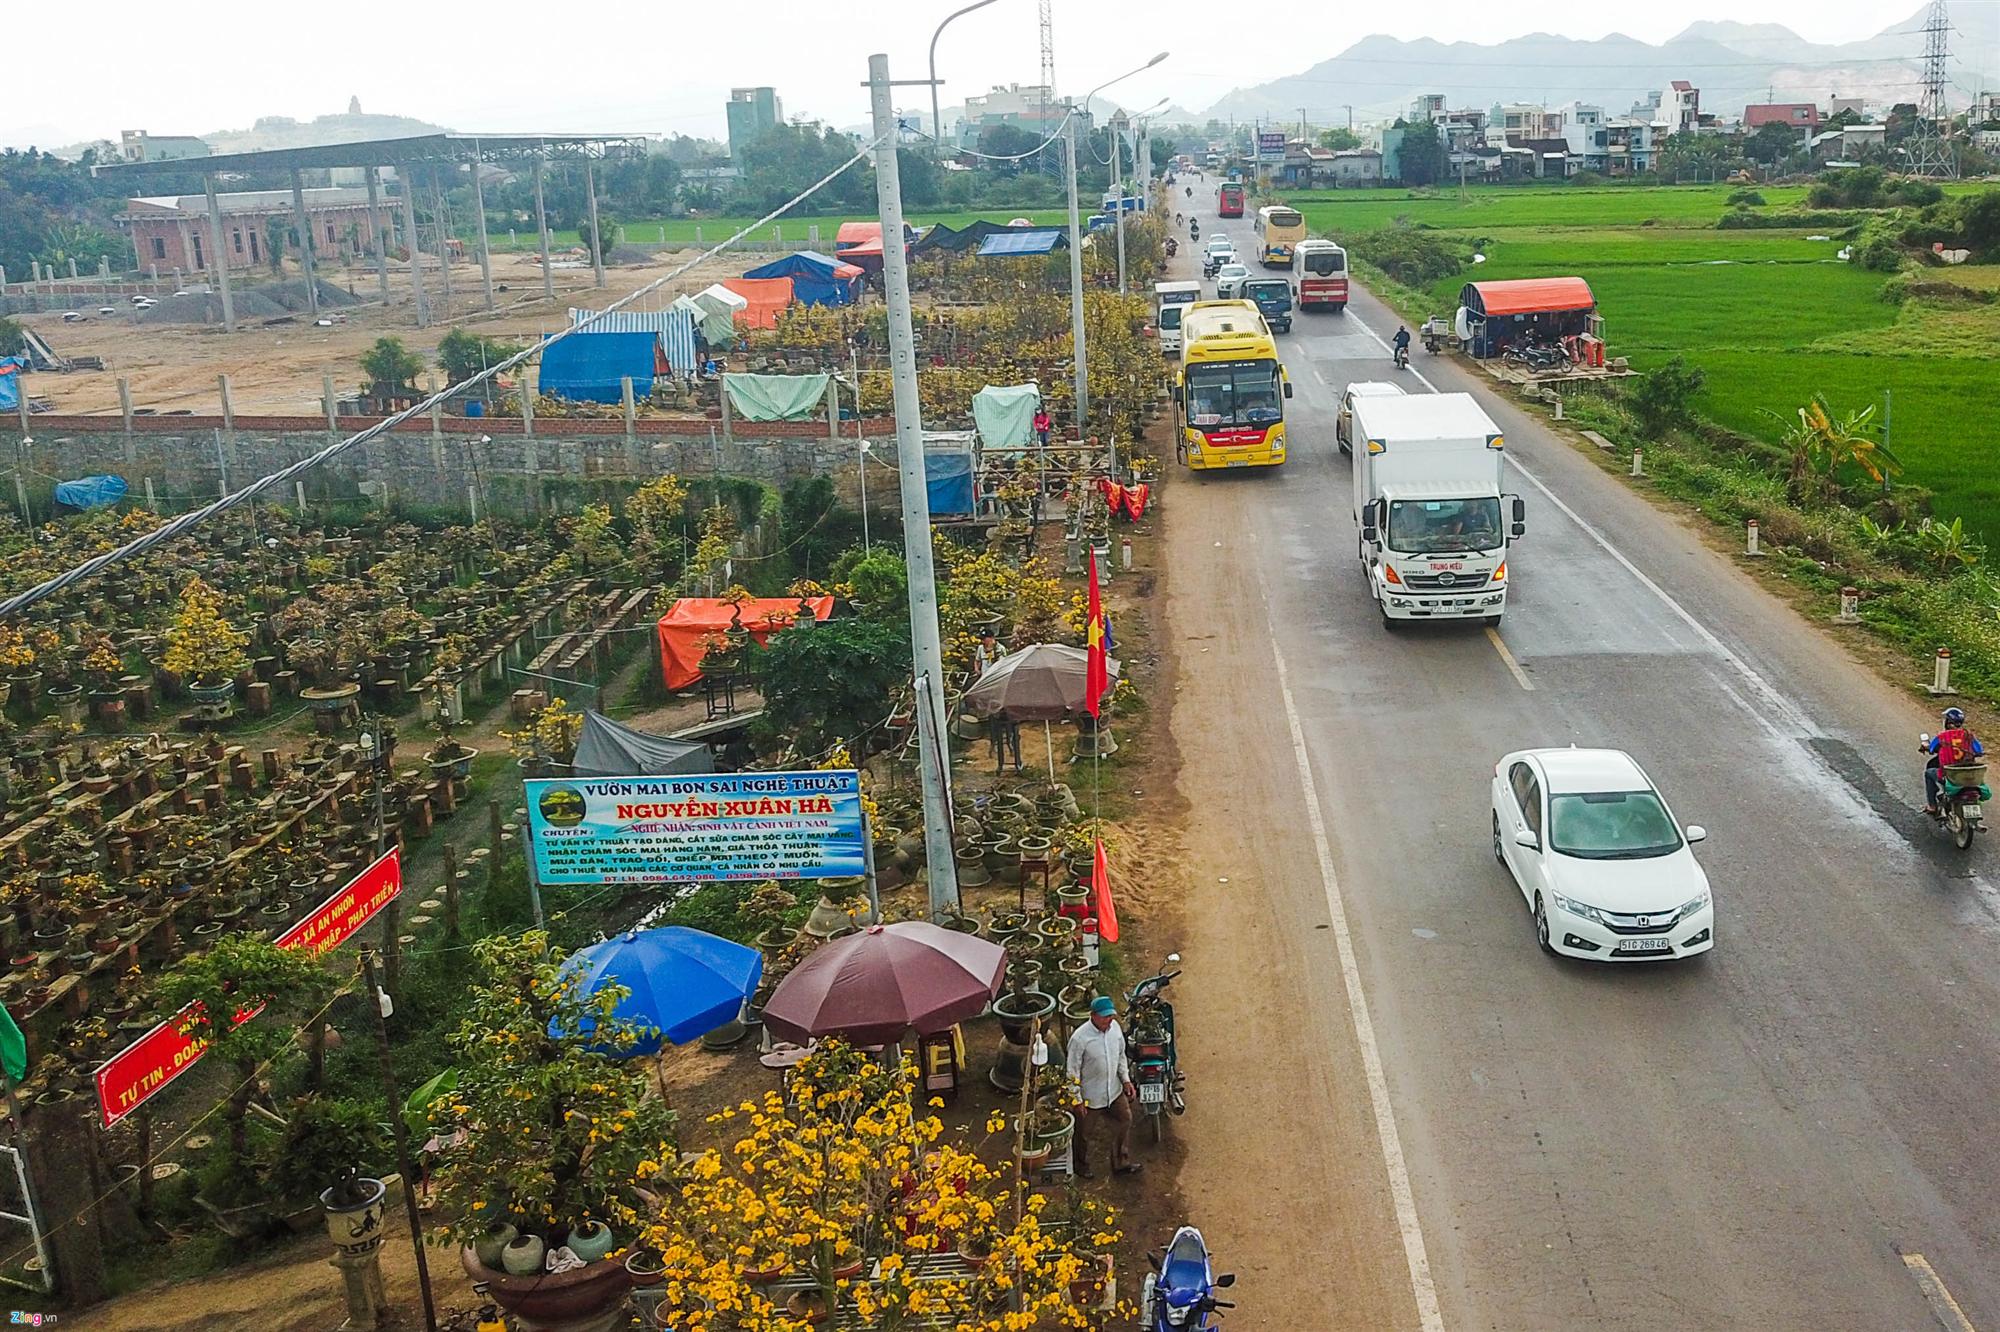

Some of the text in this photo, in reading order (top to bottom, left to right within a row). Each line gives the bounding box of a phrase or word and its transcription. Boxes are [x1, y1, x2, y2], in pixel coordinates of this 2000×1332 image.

[1952, 738, 1964, 760] 5
[585, 774, 850, 796] VƯỜN MAI BON SAI NGHỆ THUẬT
[617, 794, 833, 819] NGUYỄN XUÂN HÀ
[724, 822, 744, 830] VẬT
[784, 832, 804, 840] CÂY
[674, 854, 707, 862] GHÉP
[571, 866, 596, 874] THUÊ
[348, 903, 369, 930] PHÁT
[371, 880, 394, 910] TRIỂN
[303, 922, 316, 944] XÃ
[318, 913, 330, 933] AN
[331, 894, 355, 921] NHƠN
[119, 1081, 138, 1107] TỰ
[141, 1066, 164, 1091] TIN
